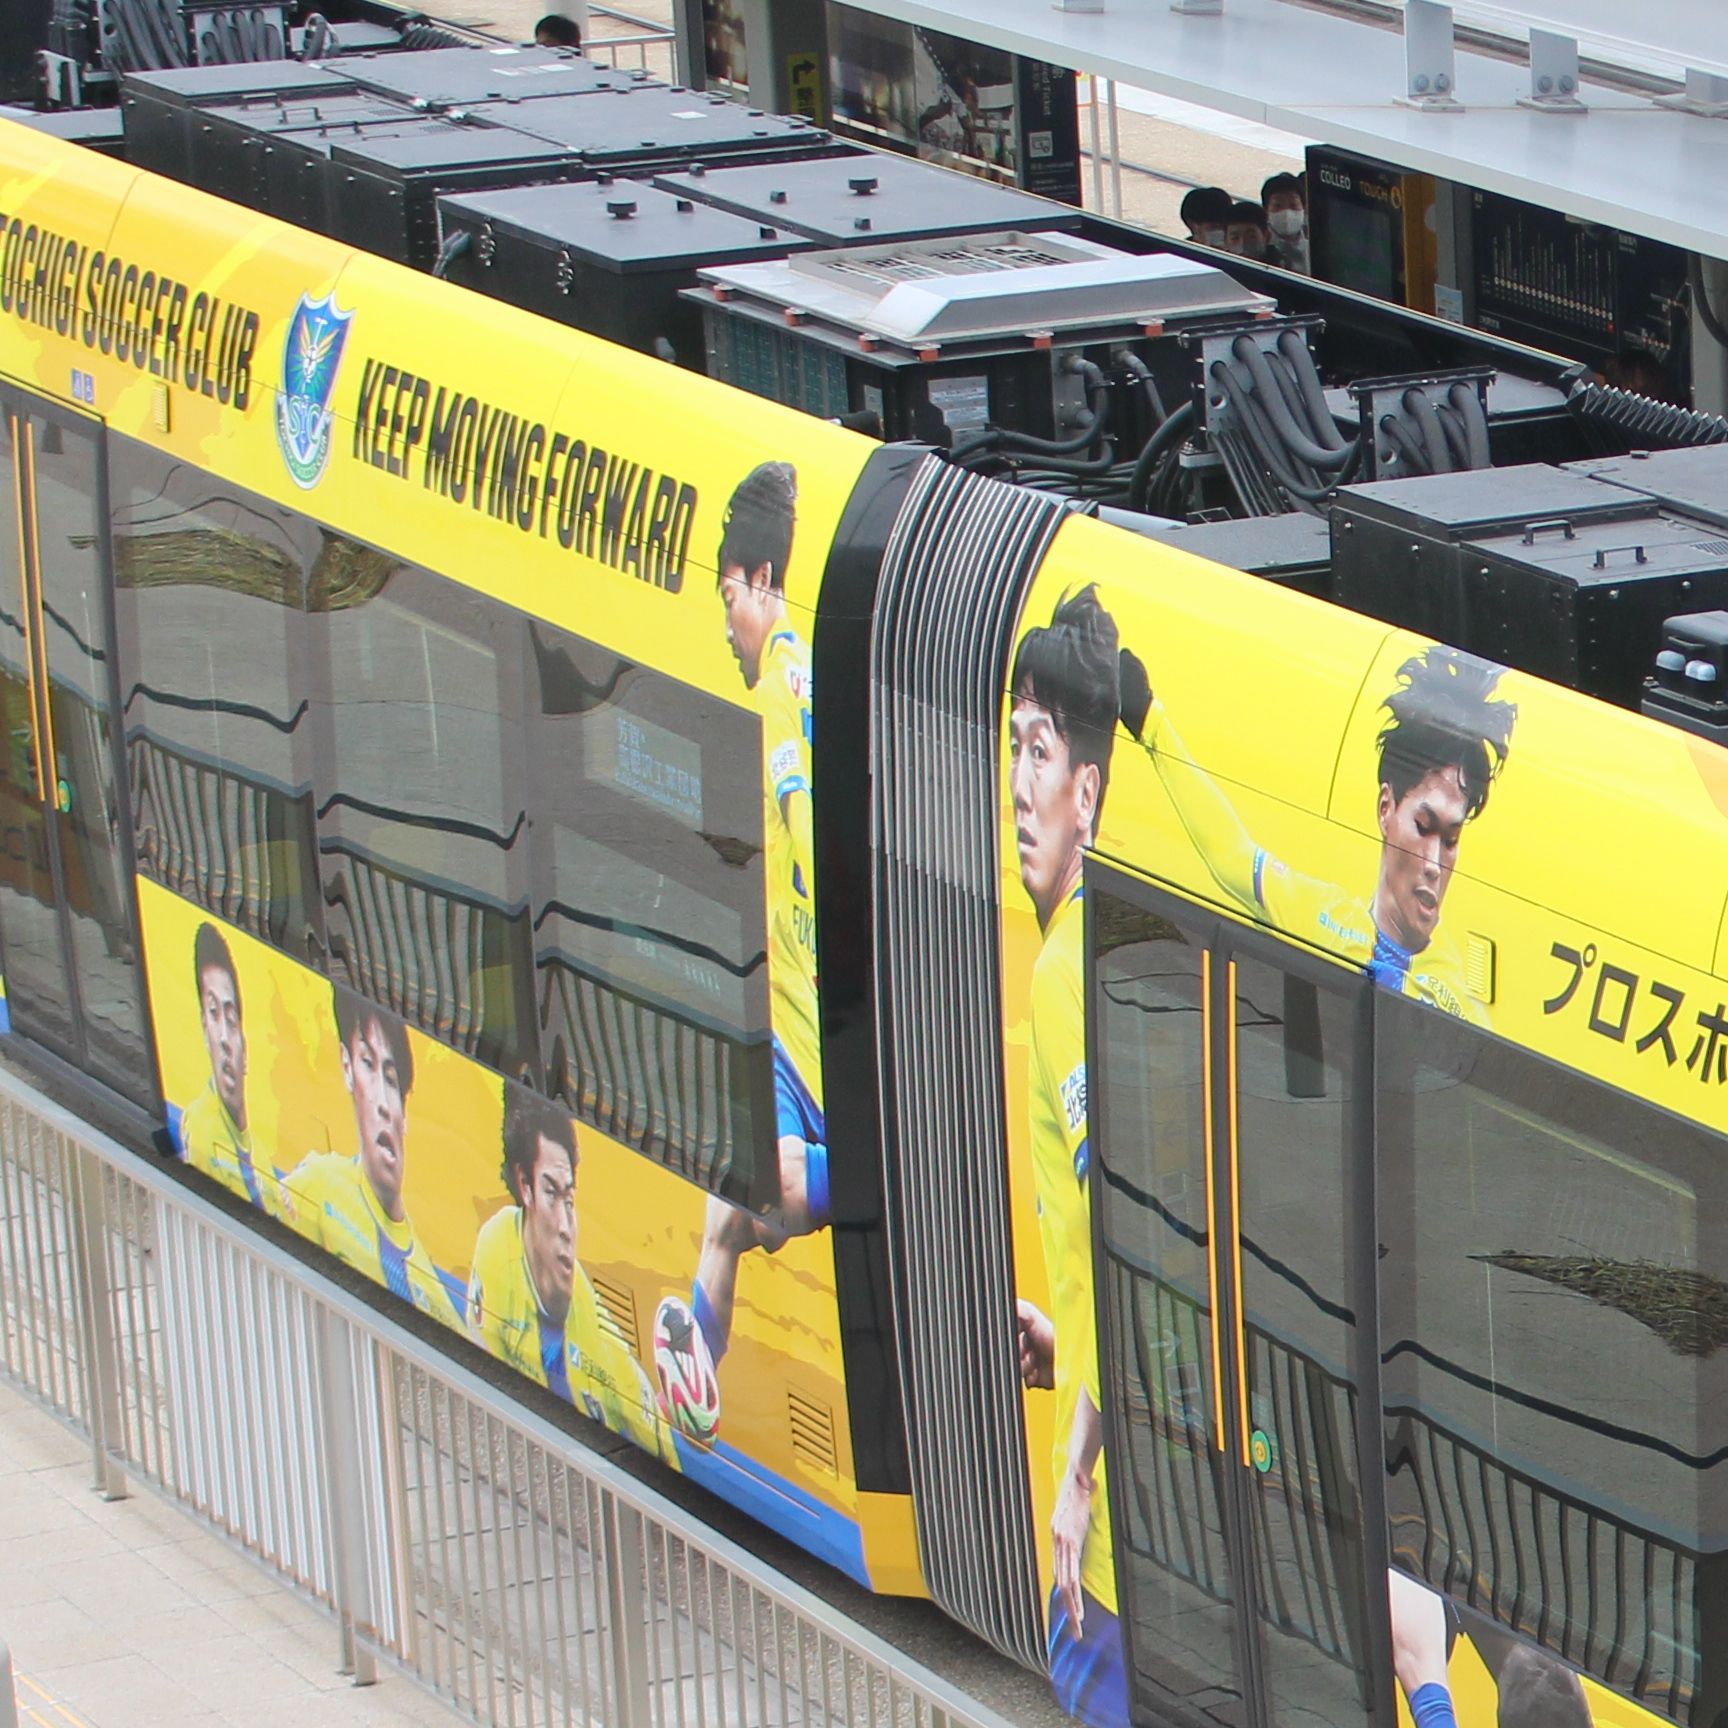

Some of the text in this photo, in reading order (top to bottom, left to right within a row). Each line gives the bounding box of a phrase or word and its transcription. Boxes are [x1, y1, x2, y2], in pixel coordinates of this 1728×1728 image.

[82, 250, 189, 384] SOCCER
[184, 291, 260, 412] CLUB
[353, 358, 431, 480] KEEP
[424, 386, 546, 533] MOVING
[539, 431, 698, 595] FORWARD
